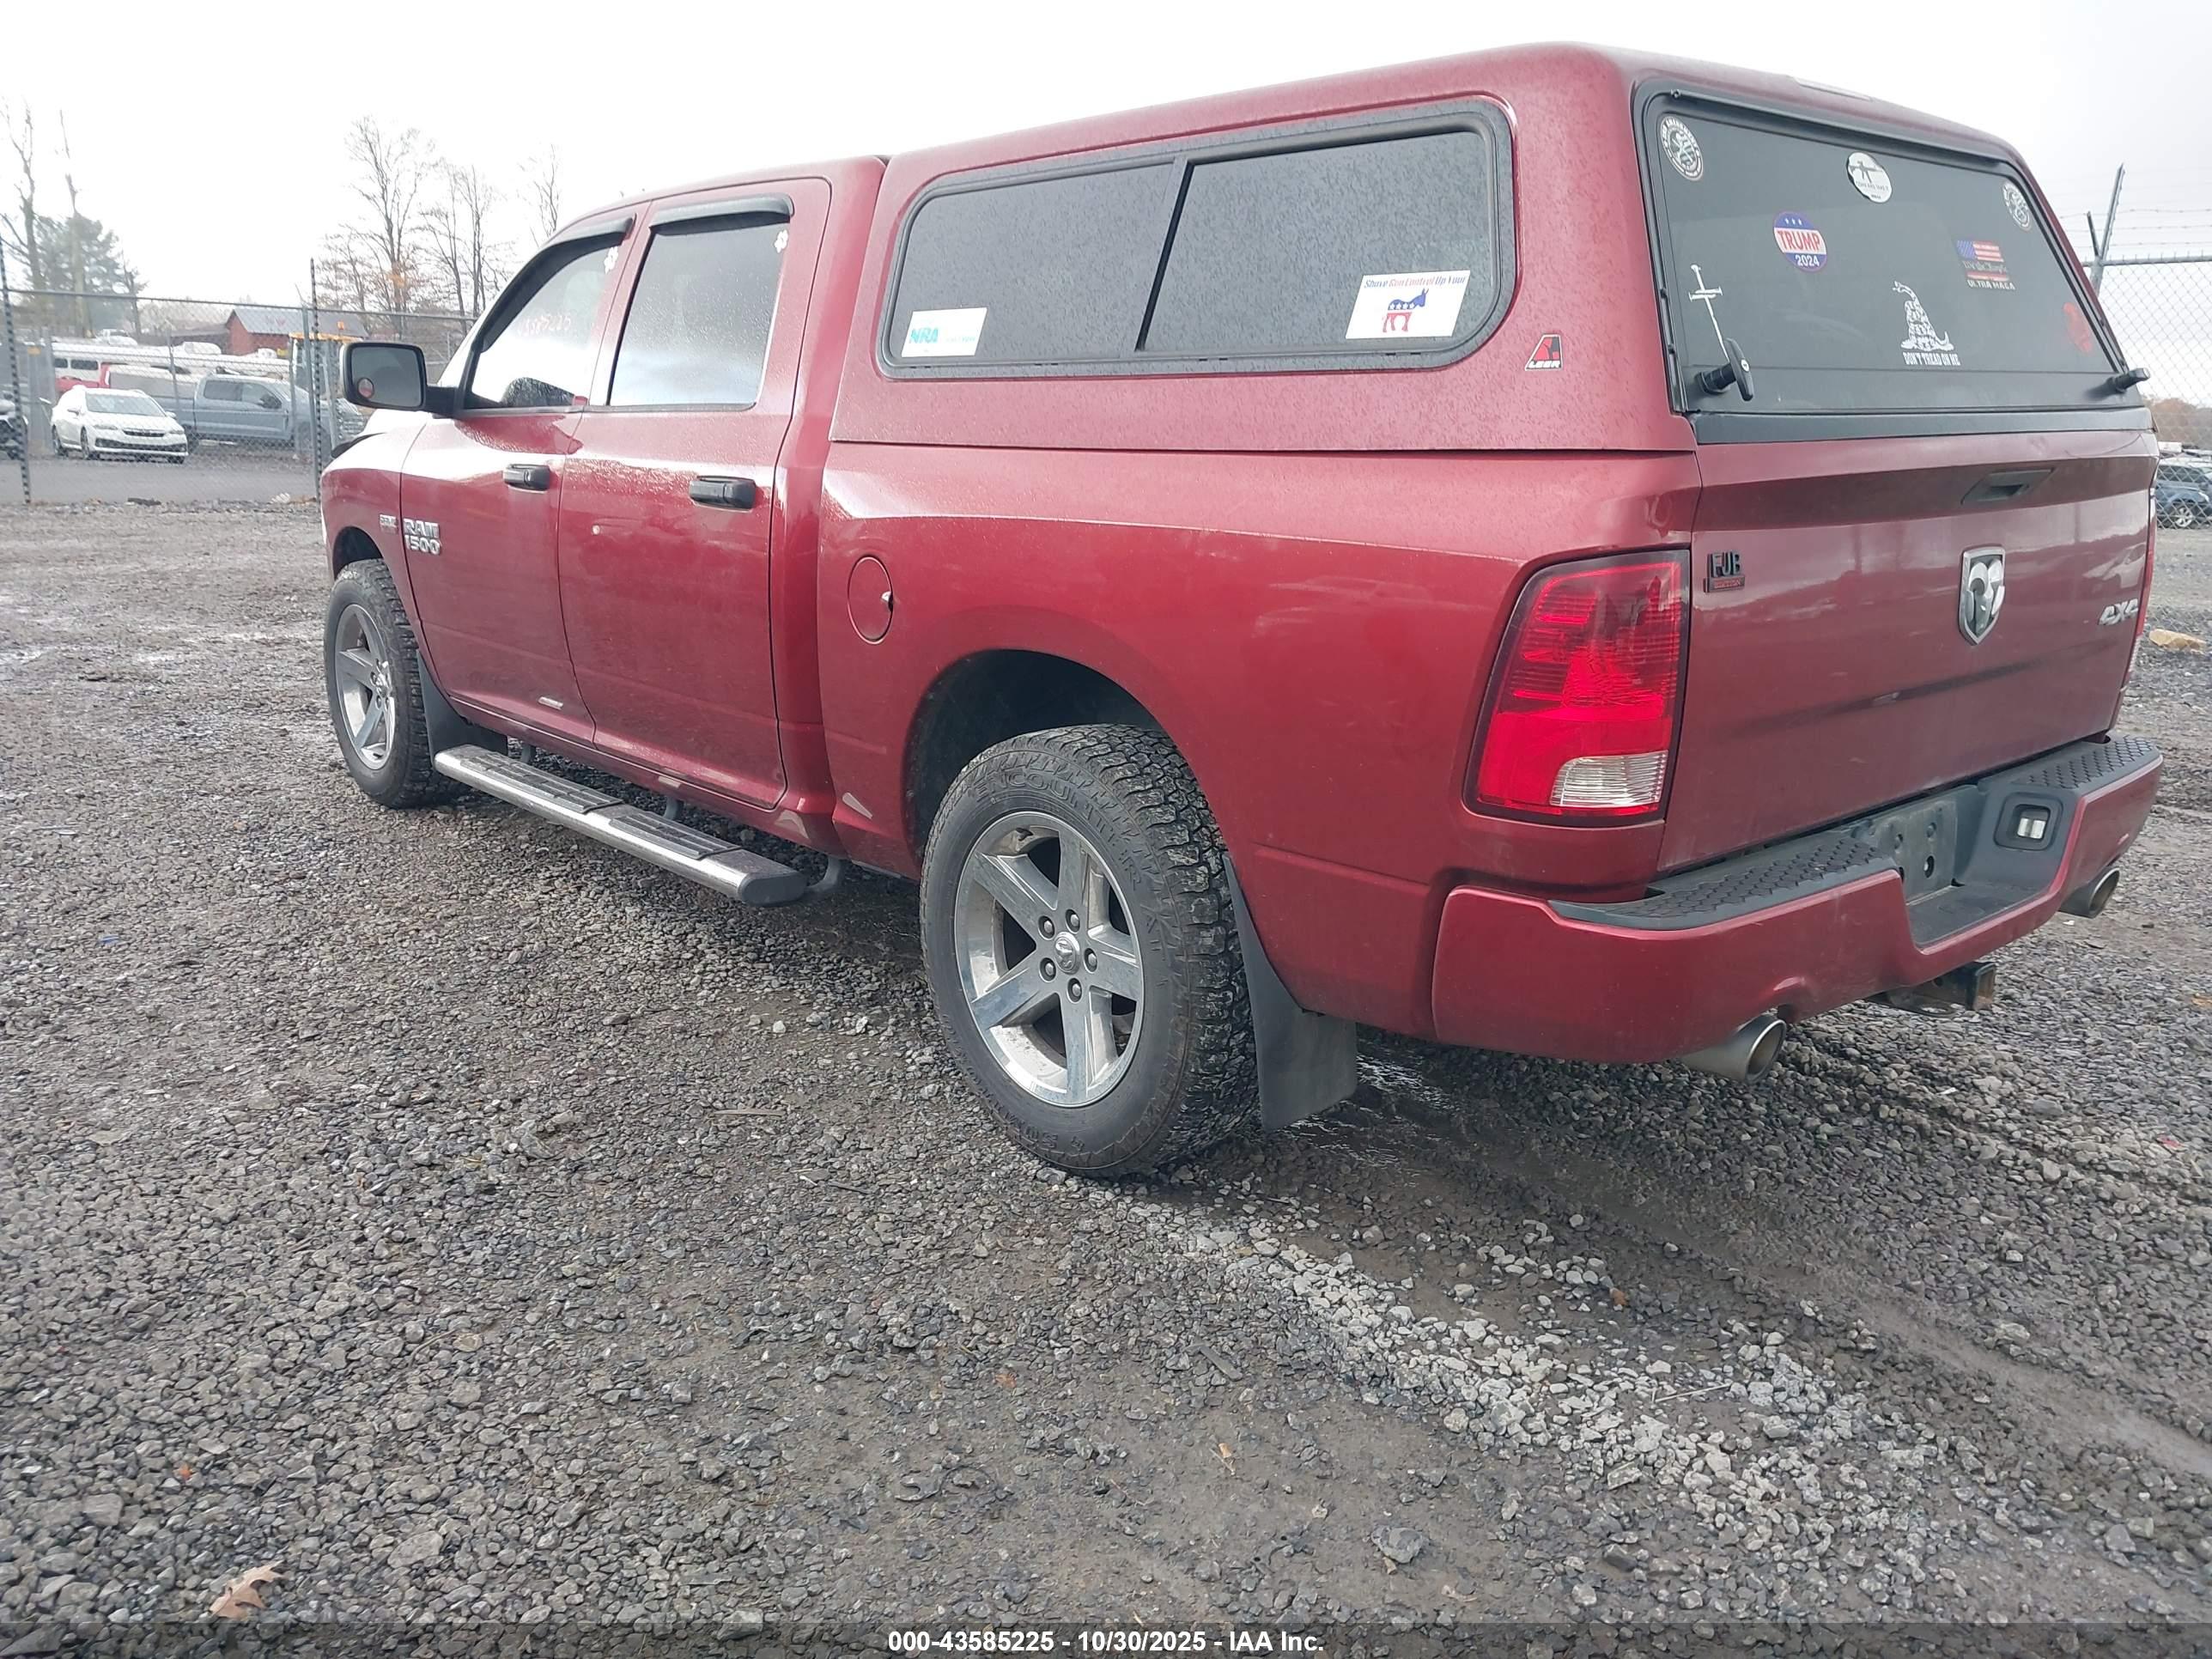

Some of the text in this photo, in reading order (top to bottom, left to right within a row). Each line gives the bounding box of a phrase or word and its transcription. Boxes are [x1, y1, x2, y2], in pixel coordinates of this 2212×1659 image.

[1777, 230, 1821, 251] TRUMP
[1795, 254, 1820, 267] 2024
[1364, 278, 1388, 289] Shove
[1435, 276, 1447, 287] Up
[1966, 279, 2016, 289] ULTRA MAGA
[909, 327, 939, 344] NRA
[1528, 360, 1561, 368] LEER
[1903, 351, 1961, 366] DON'T TREAD ON ME
[403, 518, 440, 538] RAM
[404, 534, 441, 556] 1500
